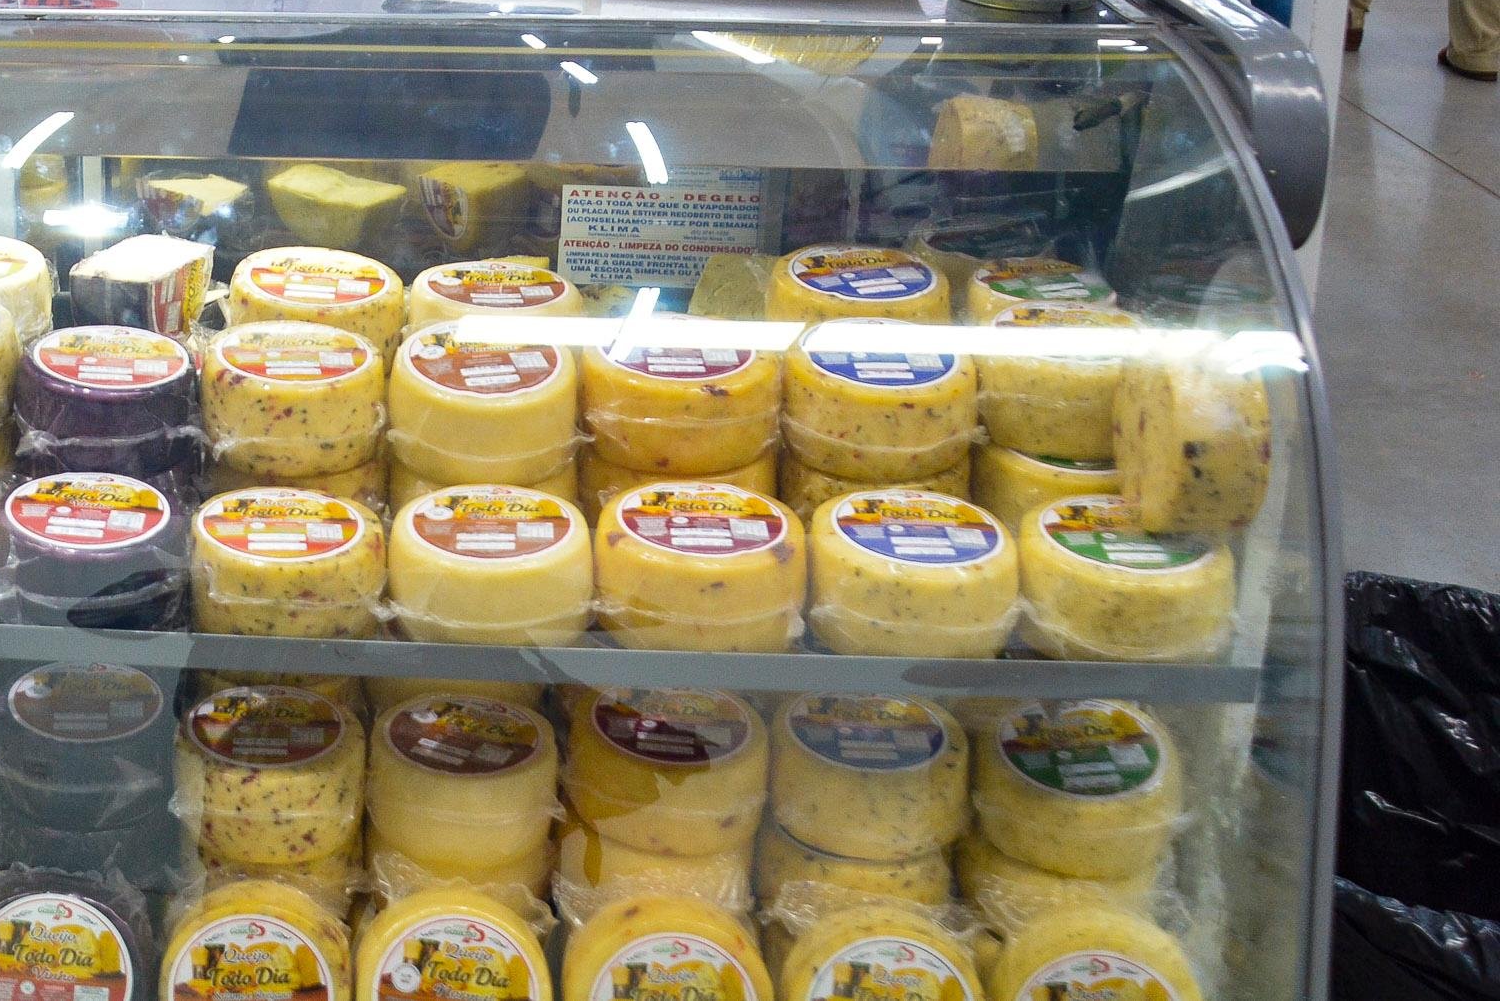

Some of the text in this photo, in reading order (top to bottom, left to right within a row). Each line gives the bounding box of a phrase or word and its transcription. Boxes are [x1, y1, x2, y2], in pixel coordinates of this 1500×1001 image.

[570, 189, 660, 200] ATENÇÃO
[684, 193, 760, 203] DEGELO
[633, 209, 668, 217] ESTIVER
[564, 240, 610, 249] ATENÇÃO
[619, 241, 662, 250] LIMPEZA
[635, 268, 676, 276] SIMPLES
[30, 925, 77, 944] Queijo
[12, 943, 94, 967] Todo Dia
[224, 947, 273, 965] Queijo
[206, 965, 290, 987] Todo Dia
[427, 961, 510, 988] Todo Dia
